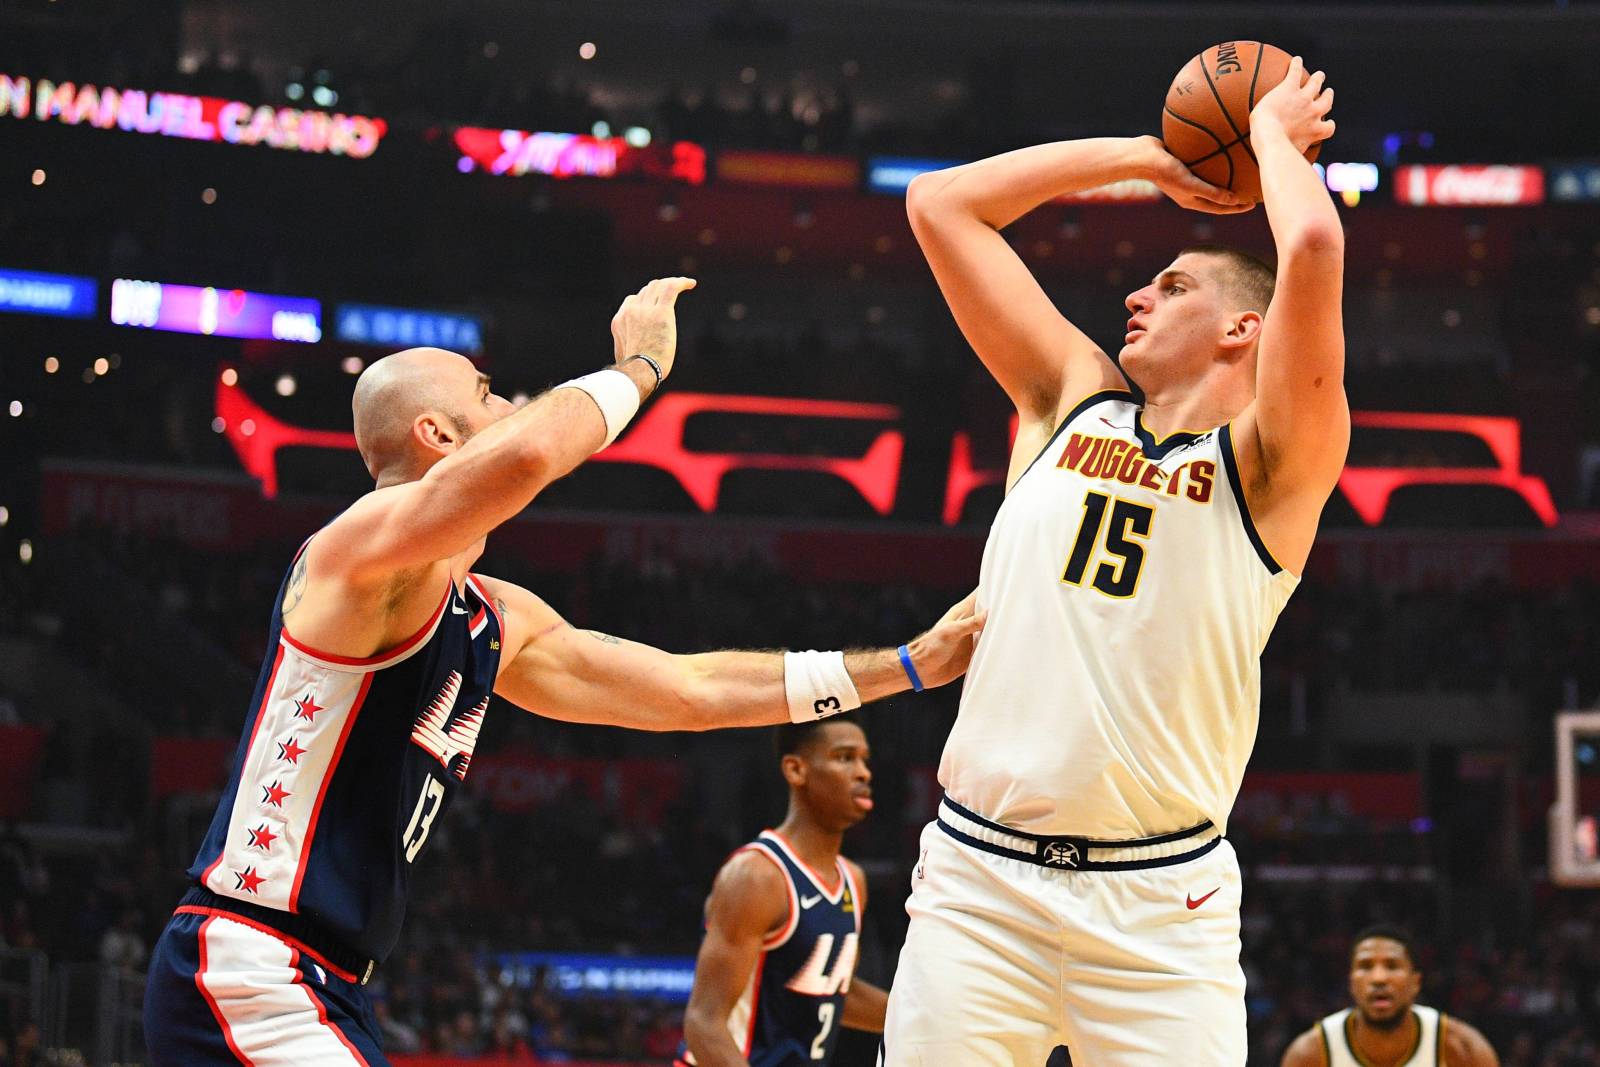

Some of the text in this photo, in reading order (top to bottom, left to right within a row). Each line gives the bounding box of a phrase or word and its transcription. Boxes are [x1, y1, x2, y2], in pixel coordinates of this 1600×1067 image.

[36, 79, 216, 141] MANUEL
[218, 102, 380, 159] CASINO
[1056, 432, 1216, 504] NUGGETS
[1061, 490, 1157, 599] 15
[402, 772, 445, 864] 13
[785, 932, 859, 996] LA
[810, 1002, 835, 1060] 2
